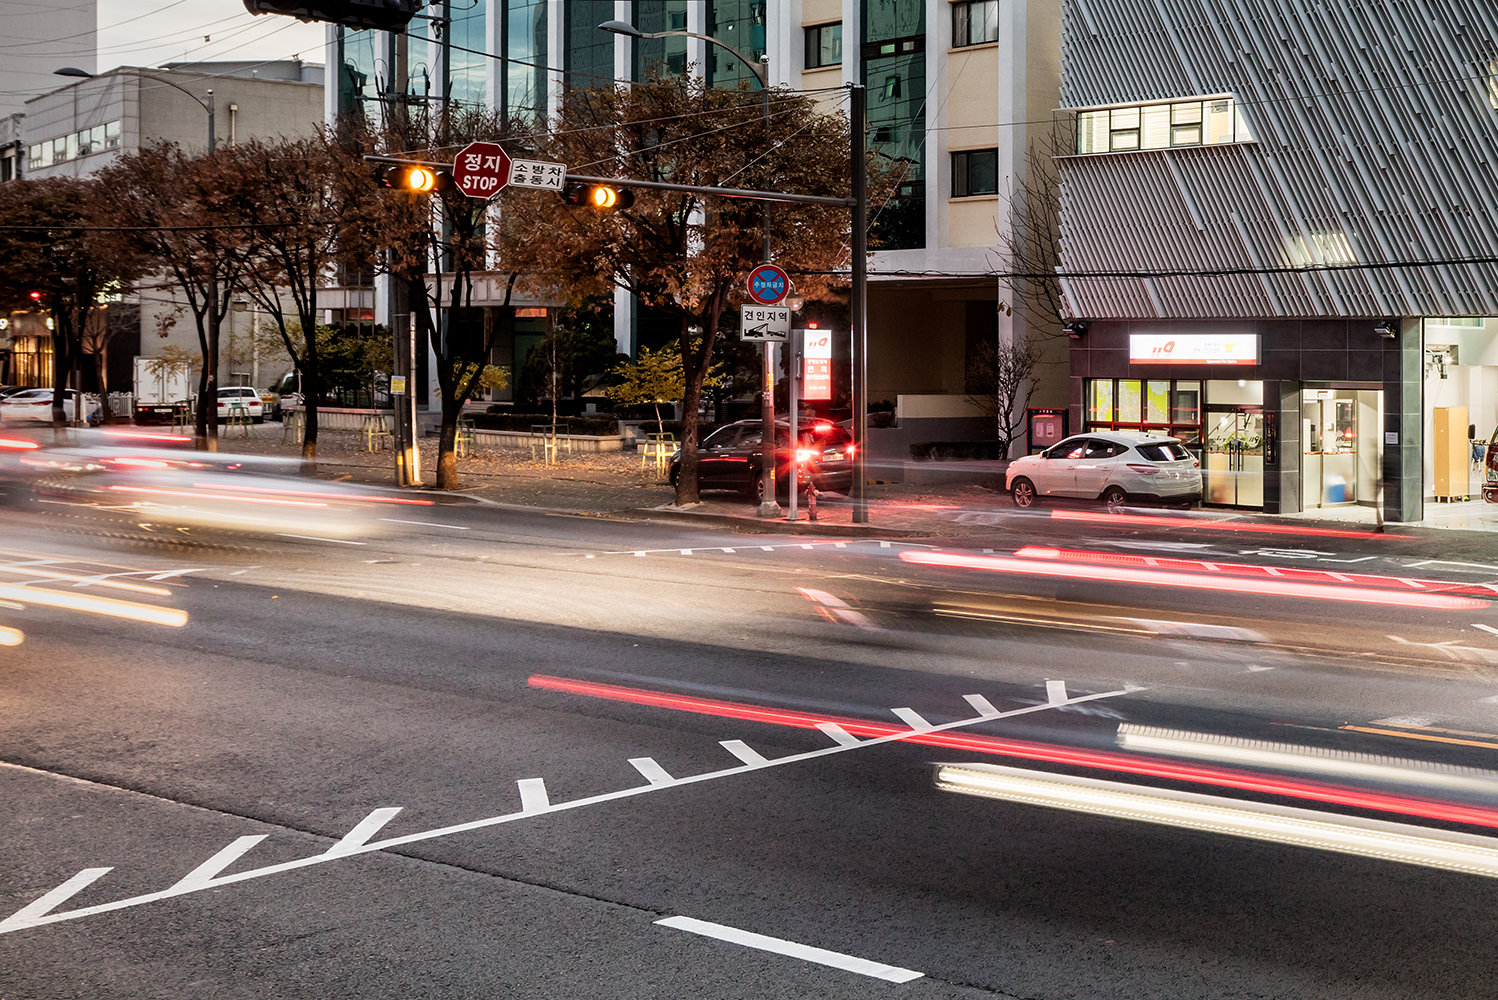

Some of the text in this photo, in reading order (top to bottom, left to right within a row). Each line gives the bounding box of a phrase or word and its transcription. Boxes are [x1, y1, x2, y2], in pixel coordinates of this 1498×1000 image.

[464, 153, 500, 173] 정지
[514, 163, 563, 177] 소방차
[462, 175, 498, 190] STOP
[513, 174, 560, 188] 출동시
[744, 310, 788, 322] 견인지역
